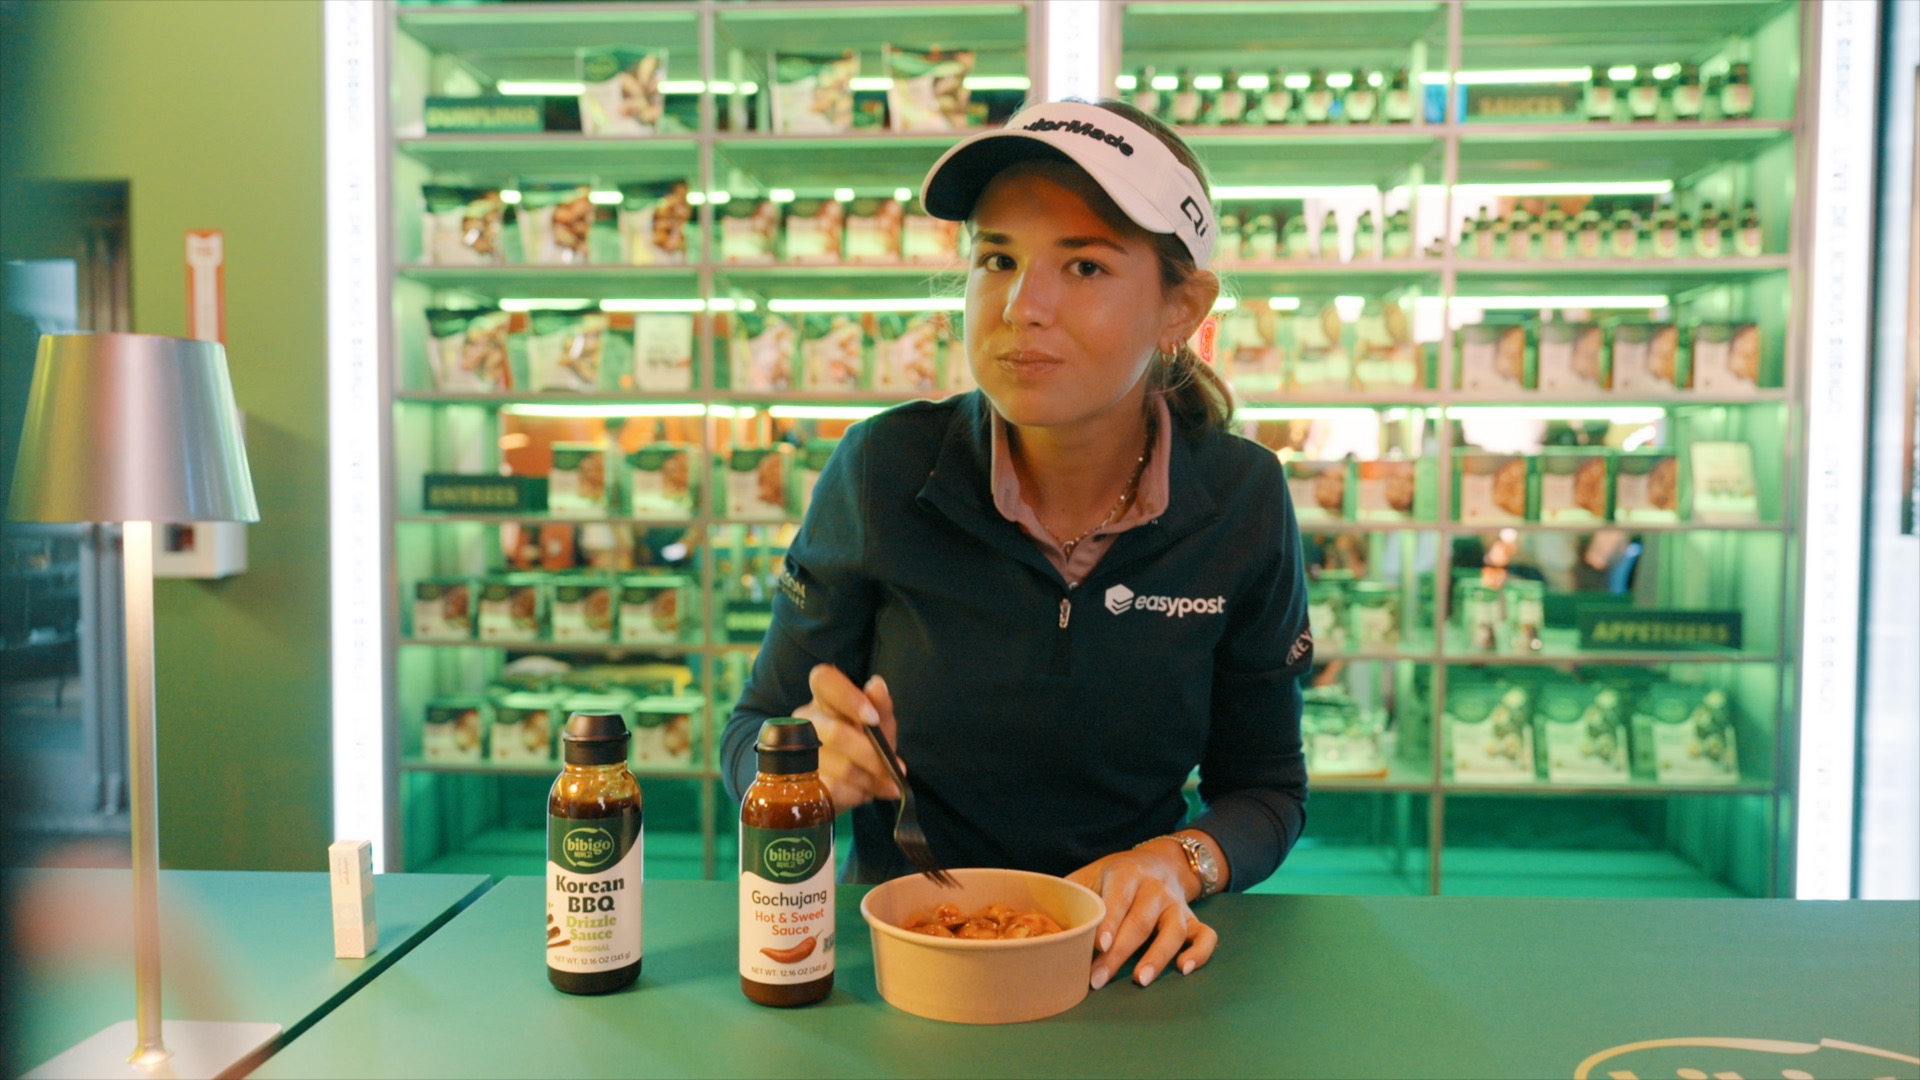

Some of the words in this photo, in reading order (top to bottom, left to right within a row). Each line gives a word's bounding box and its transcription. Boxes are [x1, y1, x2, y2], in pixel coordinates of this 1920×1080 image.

[1134, 595, 1227, 618] easypost
[567, 838, 611, 856] bibigo
[769, 848, 813, 865] bibigo
[556, 875, 624, 893] Korean
[568, 895, 615, 913] BBQ
[752, 890, 827, 909] Gochujang
[566, 915, 616, 928] Drizzle
[755, 911, 776, 923] Hot
[779, 913, 788, 923] &
[791, 908, 825, 923] Sweet
[569, 928, 613, 941] Sauce
[772, 925, 810, 936] Sauce
[572, 945, 611, 953] ORIGINAL
[598, 956, 610, 964] OZ
[751, 966, 763, 974] NET
[797, 968, 809, 976] OZ
